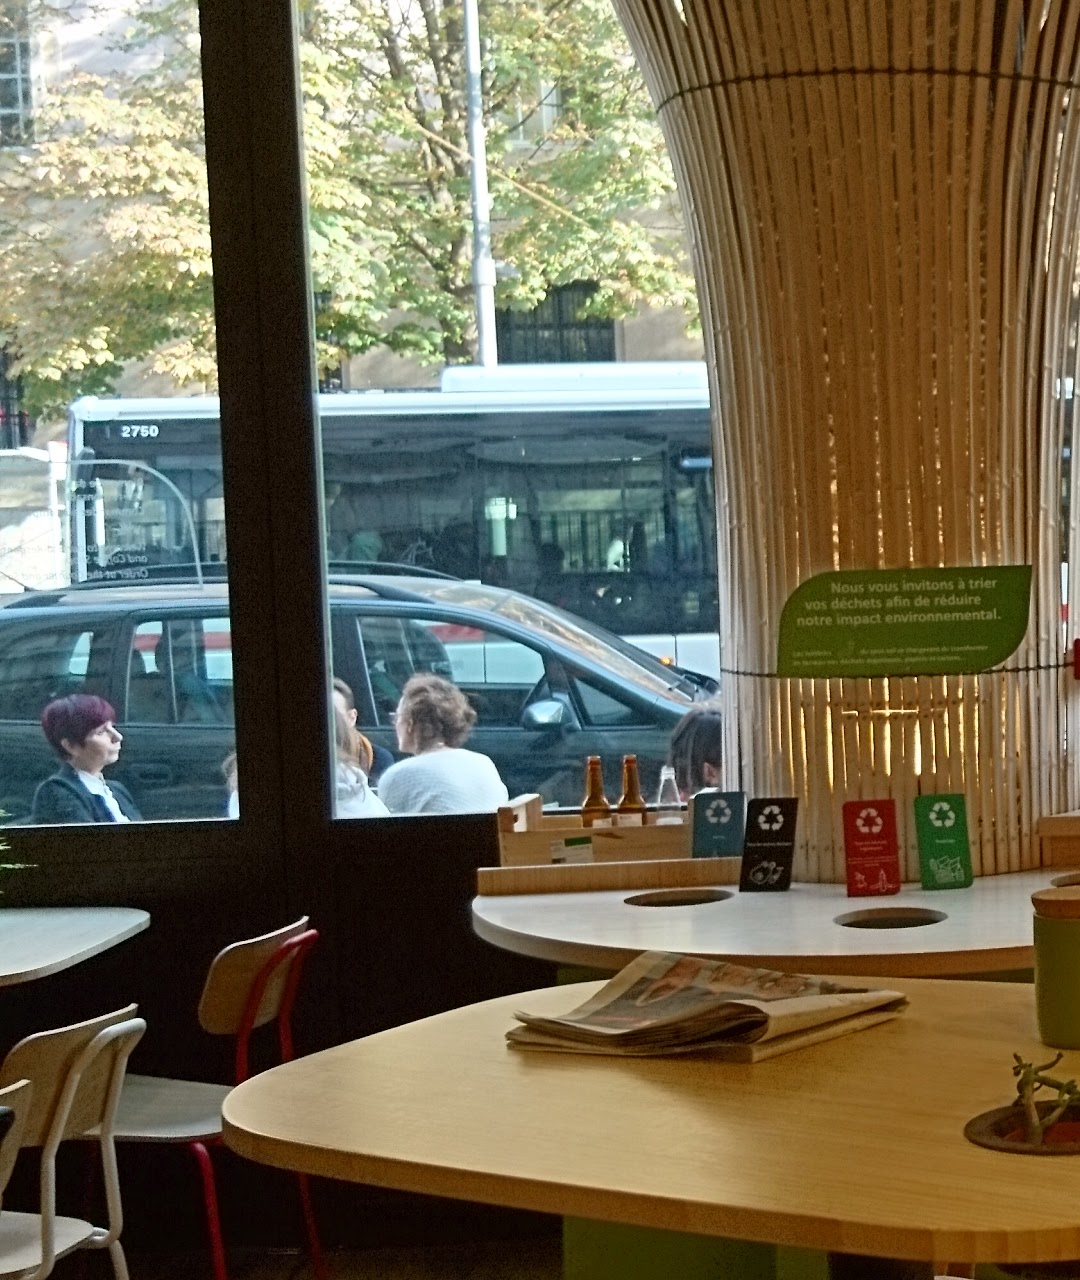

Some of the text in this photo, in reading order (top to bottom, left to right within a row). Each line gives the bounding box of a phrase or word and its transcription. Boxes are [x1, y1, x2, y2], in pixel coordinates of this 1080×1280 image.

[121, 425, 159, 437] 2750
[831, 577, 997, 593] Nous vous invitons à trier
[805, 594, 981, 610] vos déchets afin de réduire
[797, 608, 1001, 627] notre impact environnemental.
